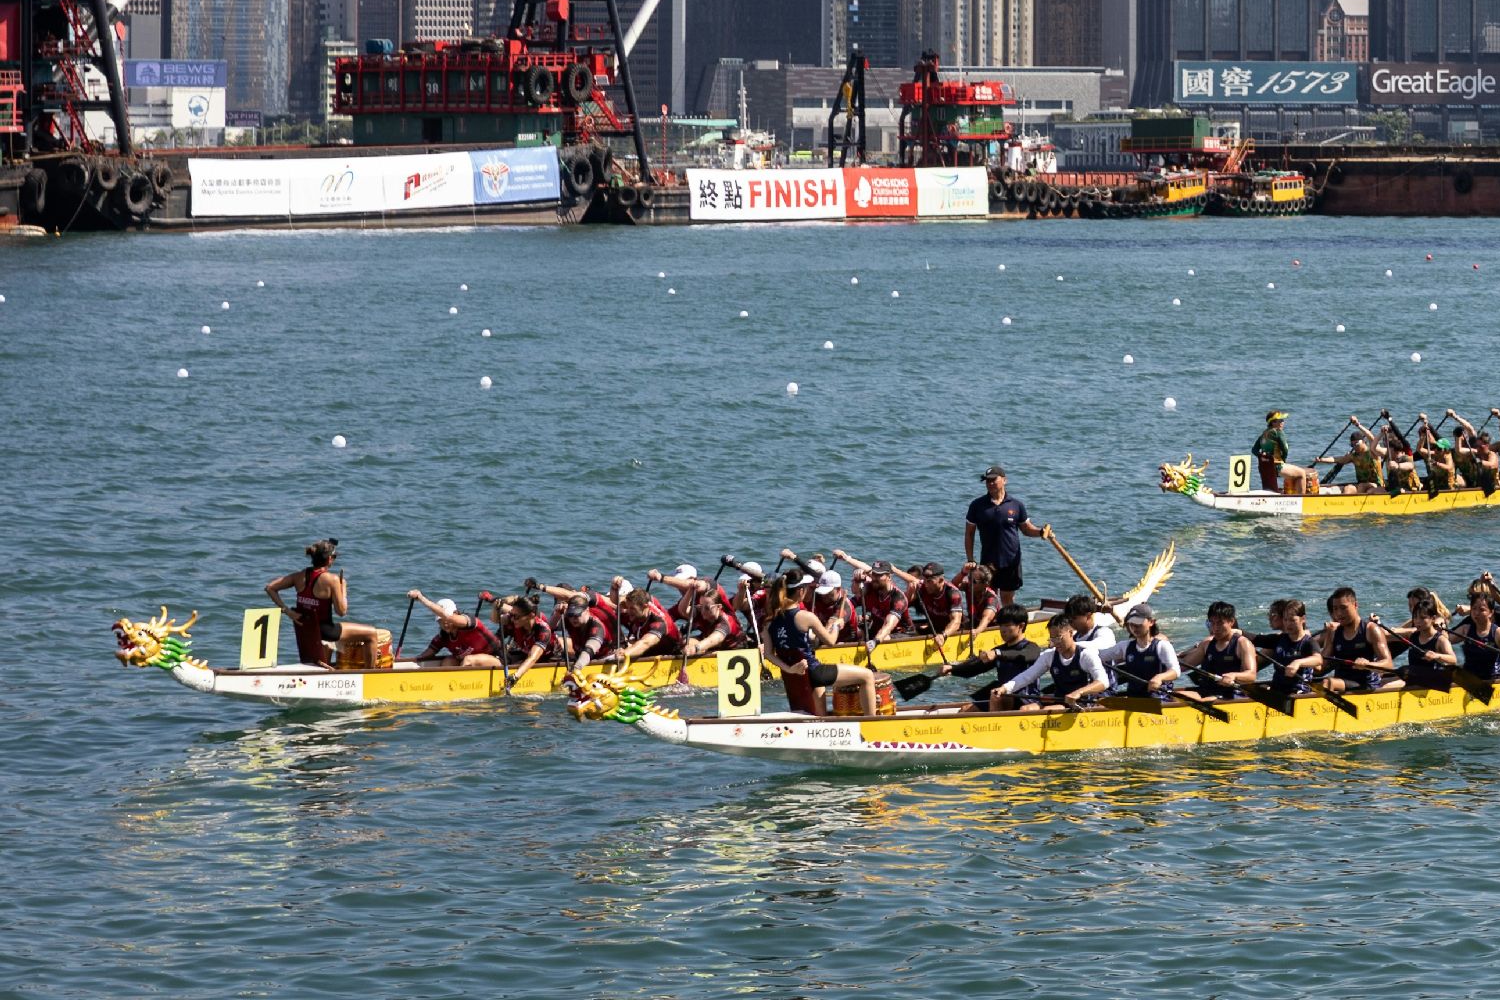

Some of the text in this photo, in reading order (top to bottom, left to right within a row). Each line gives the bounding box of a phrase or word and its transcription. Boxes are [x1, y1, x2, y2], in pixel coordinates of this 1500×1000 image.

[163, 63, 215, 74] BEWG
[1372, 69, 1434, 94] Great
[1437, 69, 1496, 100] Eagle
[699, 179, 838, 209] 終點 FINISH
[1234, 459, 1247, 488] 9
[253, 614, 270, 659] 1
[317, 680, 356, 689] HKCDBA
[727, 656, 752, 707] 3
[1428, 695, 1454, 705] Sun Life
[1376, 701, 1389, 710] Sun
[972, 722, 1002, 733] Sun Life
[1031, 720, 1046, 729] Sun
[1091, 718, 1121, 728] Sun Life
[807, 728, 851, 738] HKCDBA
[914, 726, 943, 736] Sun Life
